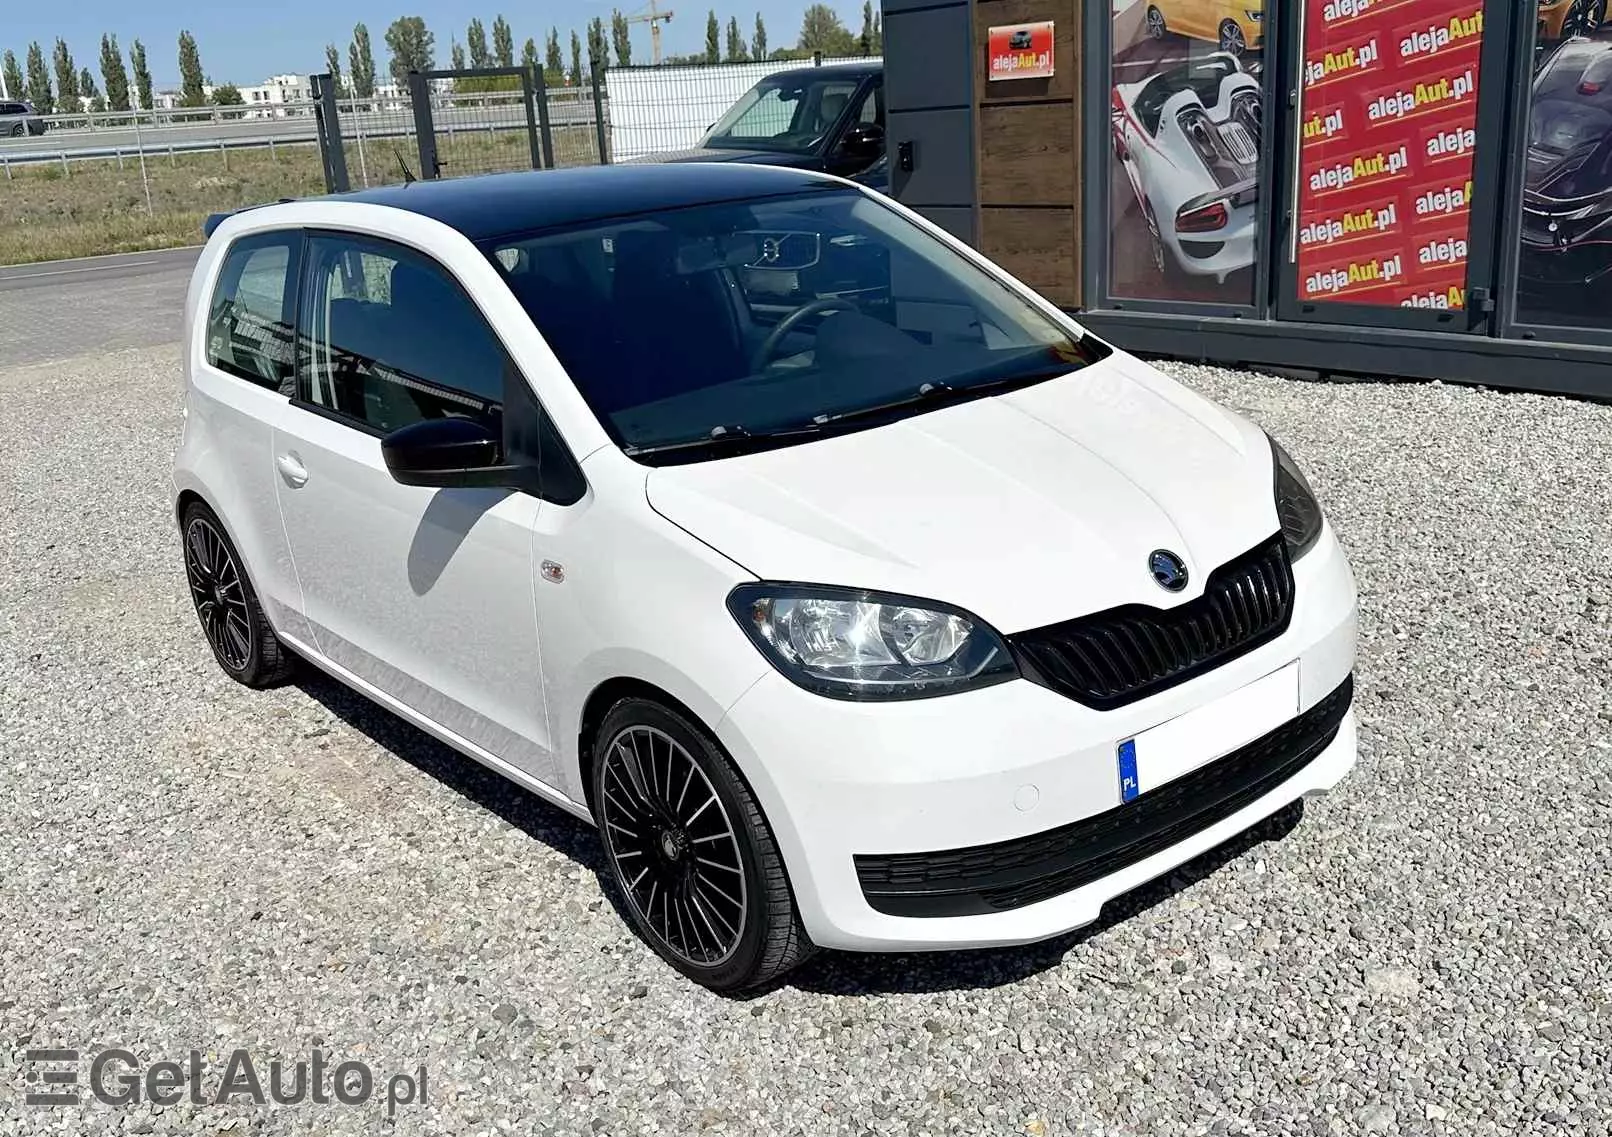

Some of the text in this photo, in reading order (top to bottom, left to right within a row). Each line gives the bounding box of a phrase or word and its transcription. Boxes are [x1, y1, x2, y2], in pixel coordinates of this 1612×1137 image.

[1323, 0, 1383, 21] aleja
[993, 50, 1050, 72] alejaAut.pl
[1368, 71, 1473, 120] alejaAut.pl
[1310, 147, 1408, 190] alejaAut.pl
[1300, 203, 1397, 244] alejaAut.pl
[1306, 255, 1402, 293] alejaAut.pl
[1124, 776, 1136, 791] PL
